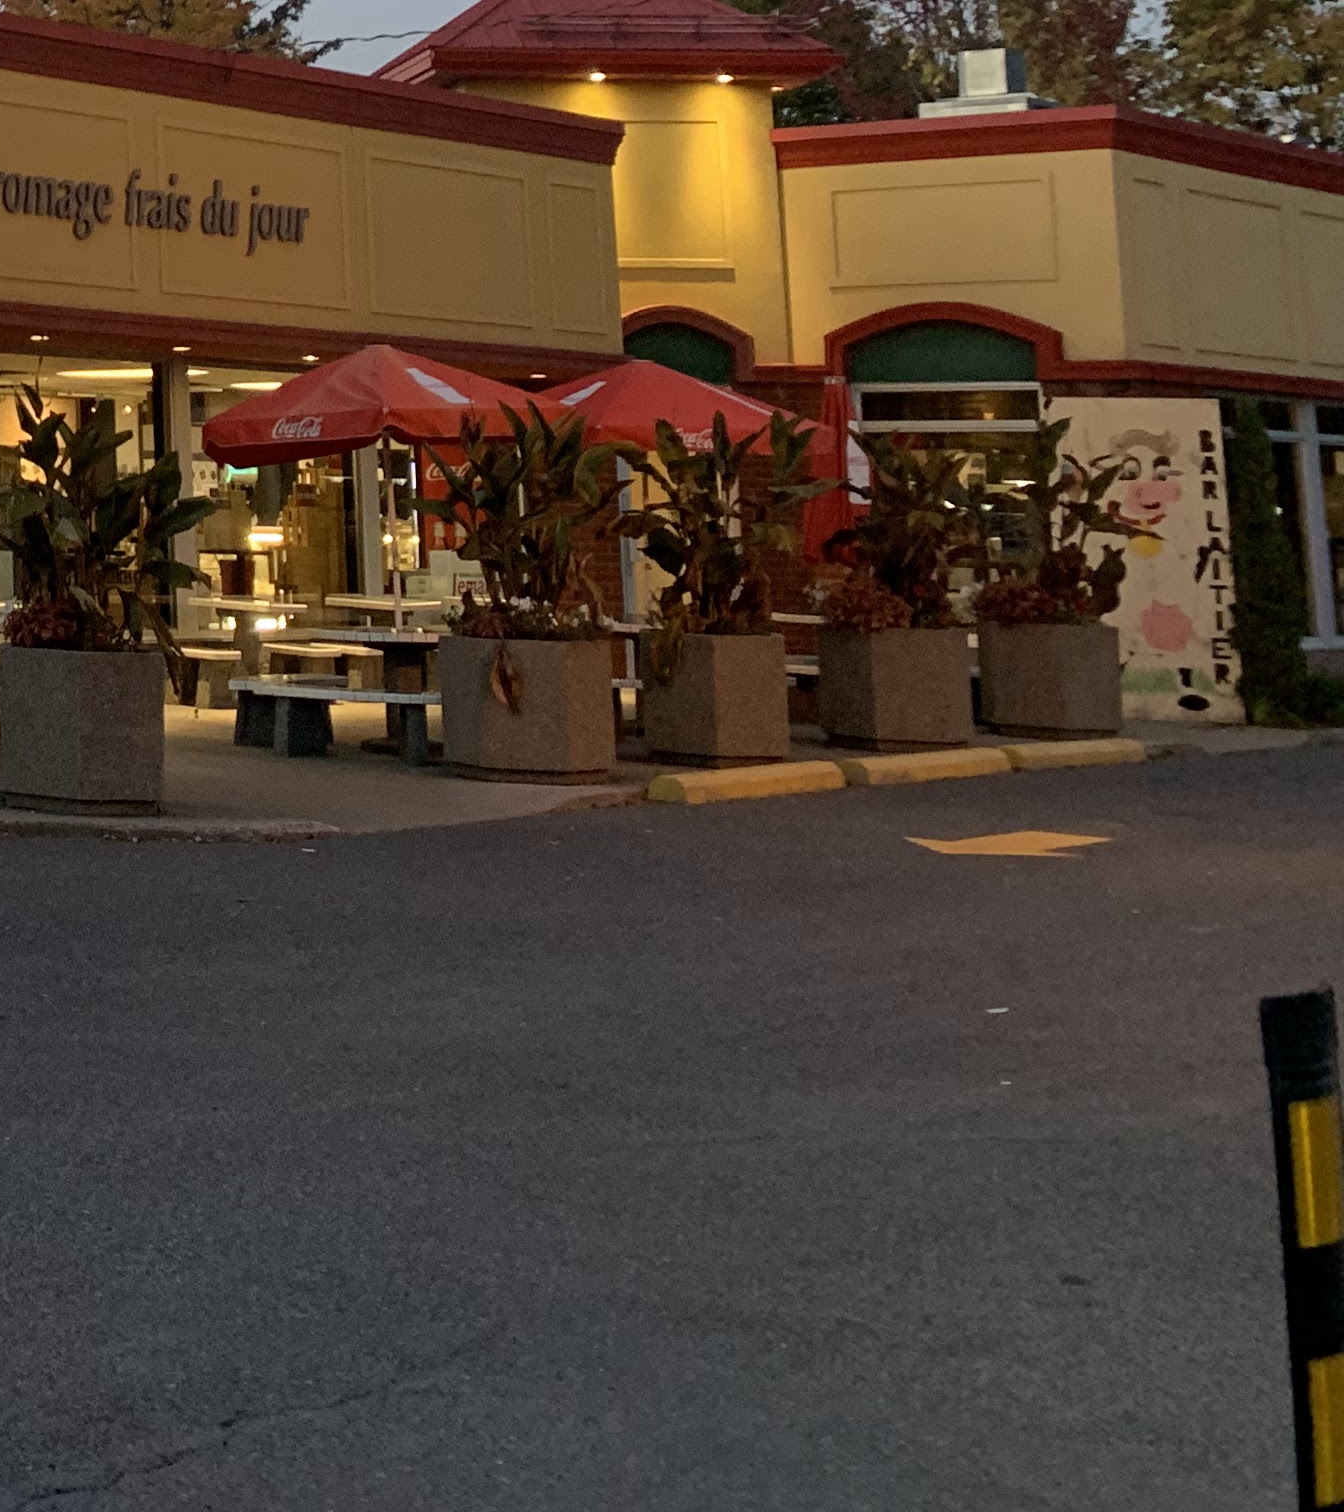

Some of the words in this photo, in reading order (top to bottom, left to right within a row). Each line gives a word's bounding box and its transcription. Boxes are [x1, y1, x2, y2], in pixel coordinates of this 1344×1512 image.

[124, 169, 192, 233] frais
[200, 179, 241, 238] du
[245, 186, 310, 257] jour
[1198, 429, 1219, 500] BAR
[1205, 510, 1234, 685] LAITIER
